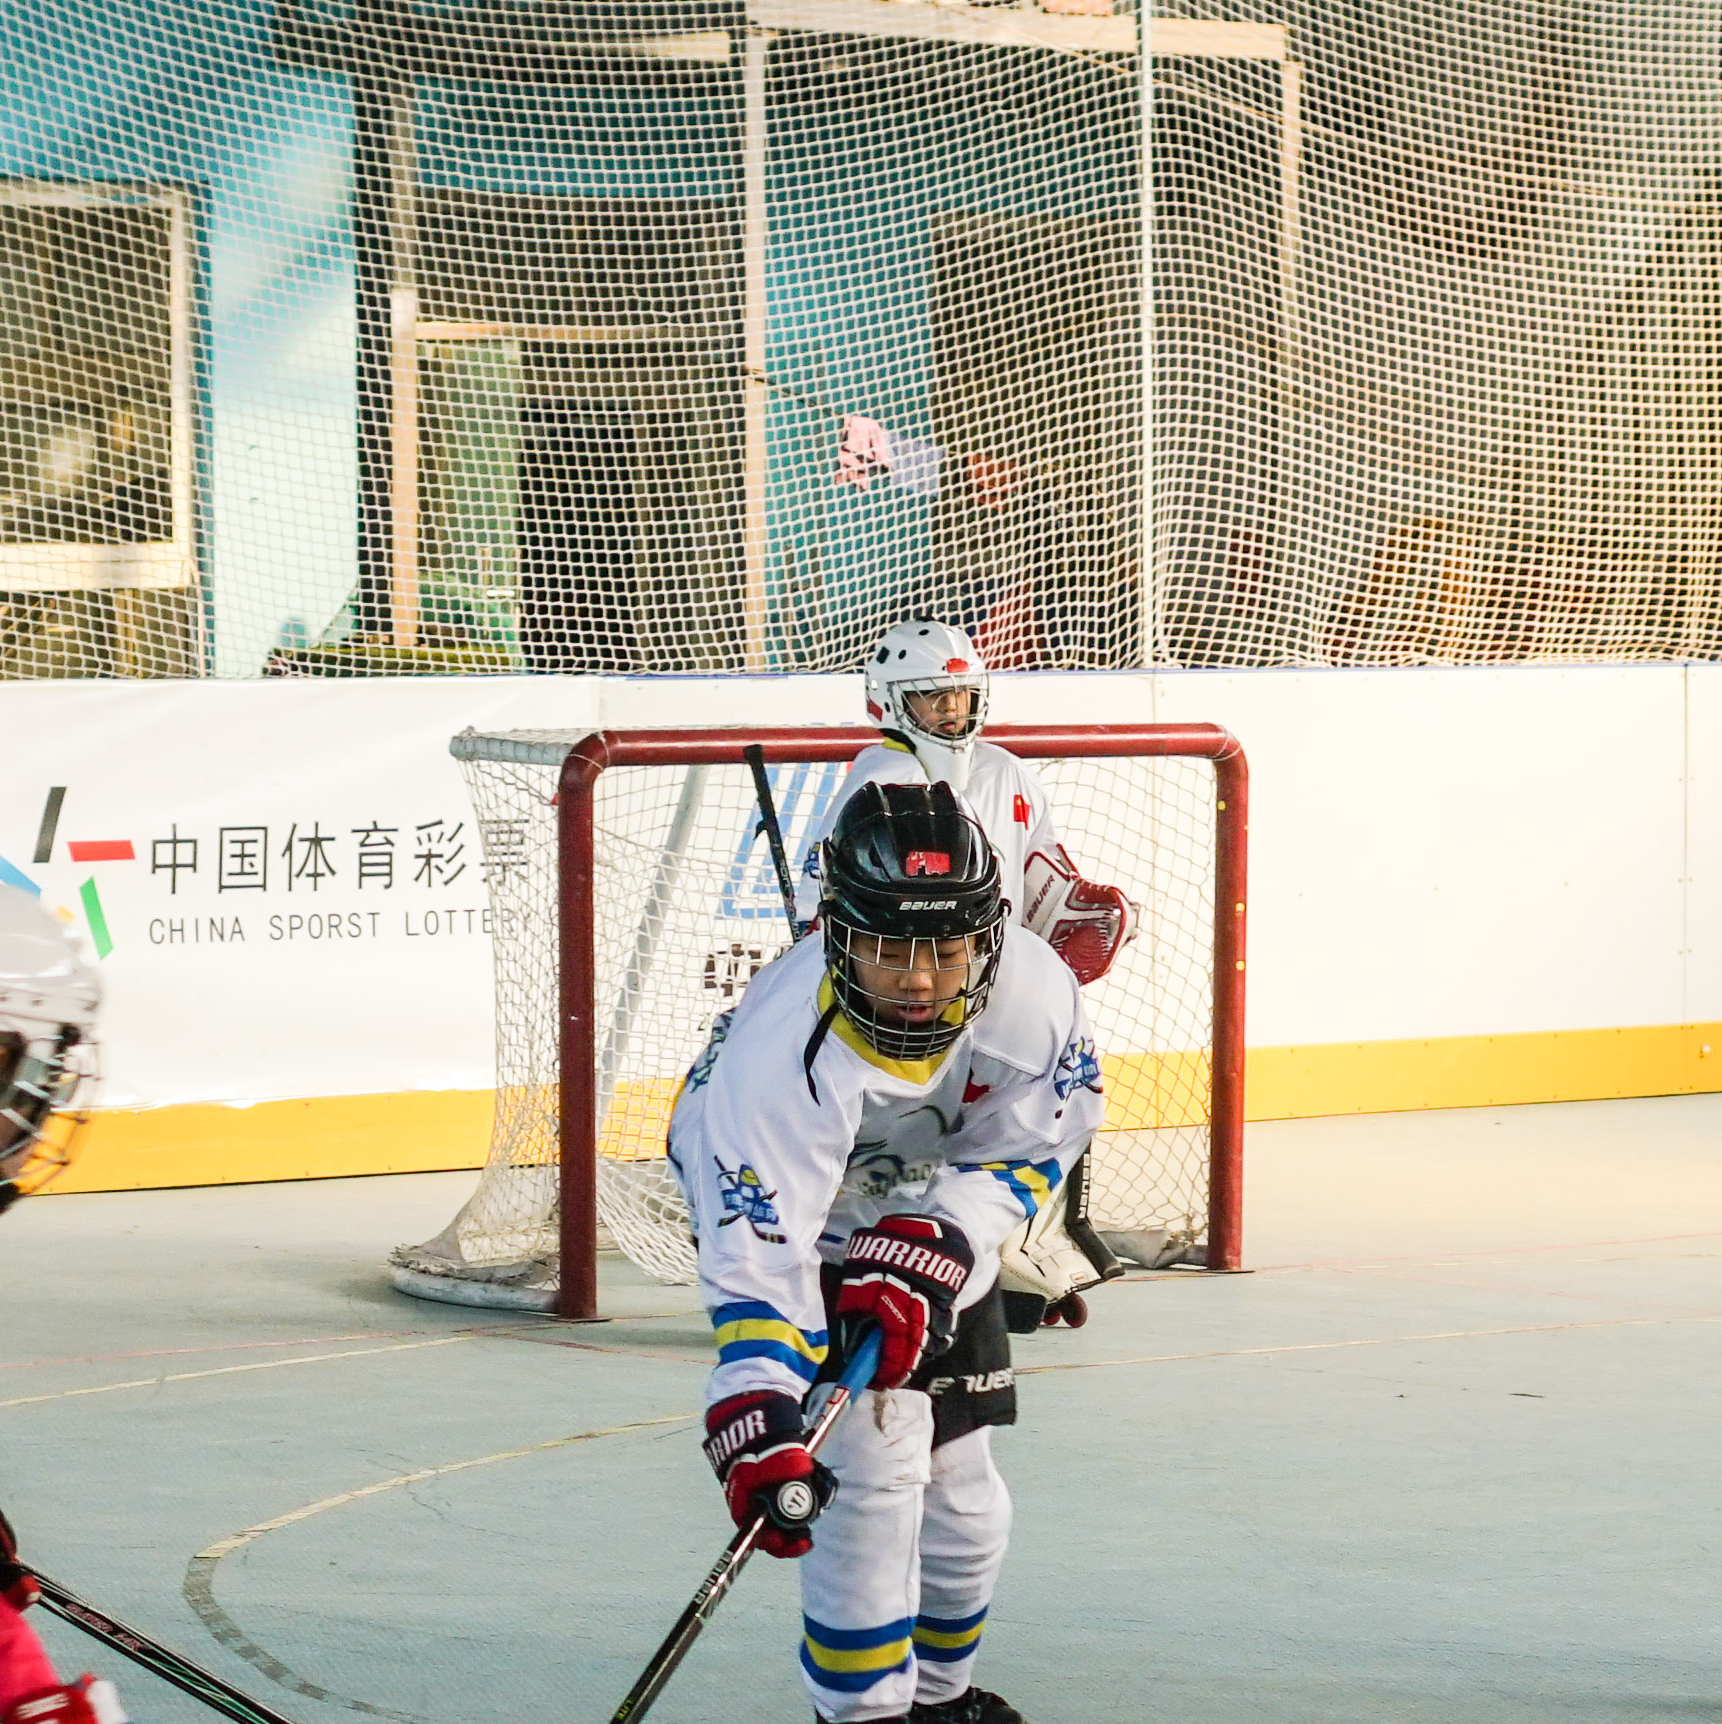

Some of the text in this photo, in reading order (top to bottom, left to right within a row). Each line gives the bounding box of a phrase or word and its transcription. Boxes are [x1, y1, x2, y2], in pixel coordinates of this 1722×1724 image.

[149, 818, 531, 896] 中国体育彩票
[898, 899, 958, 911] BAUER
[1026, 874, 1056, 924] BAUER
[148, 917, 246, 945] CHINA
[268, 912, 381, 941] SPORST
[845, 1236, 967, 1292] WARRIOR
